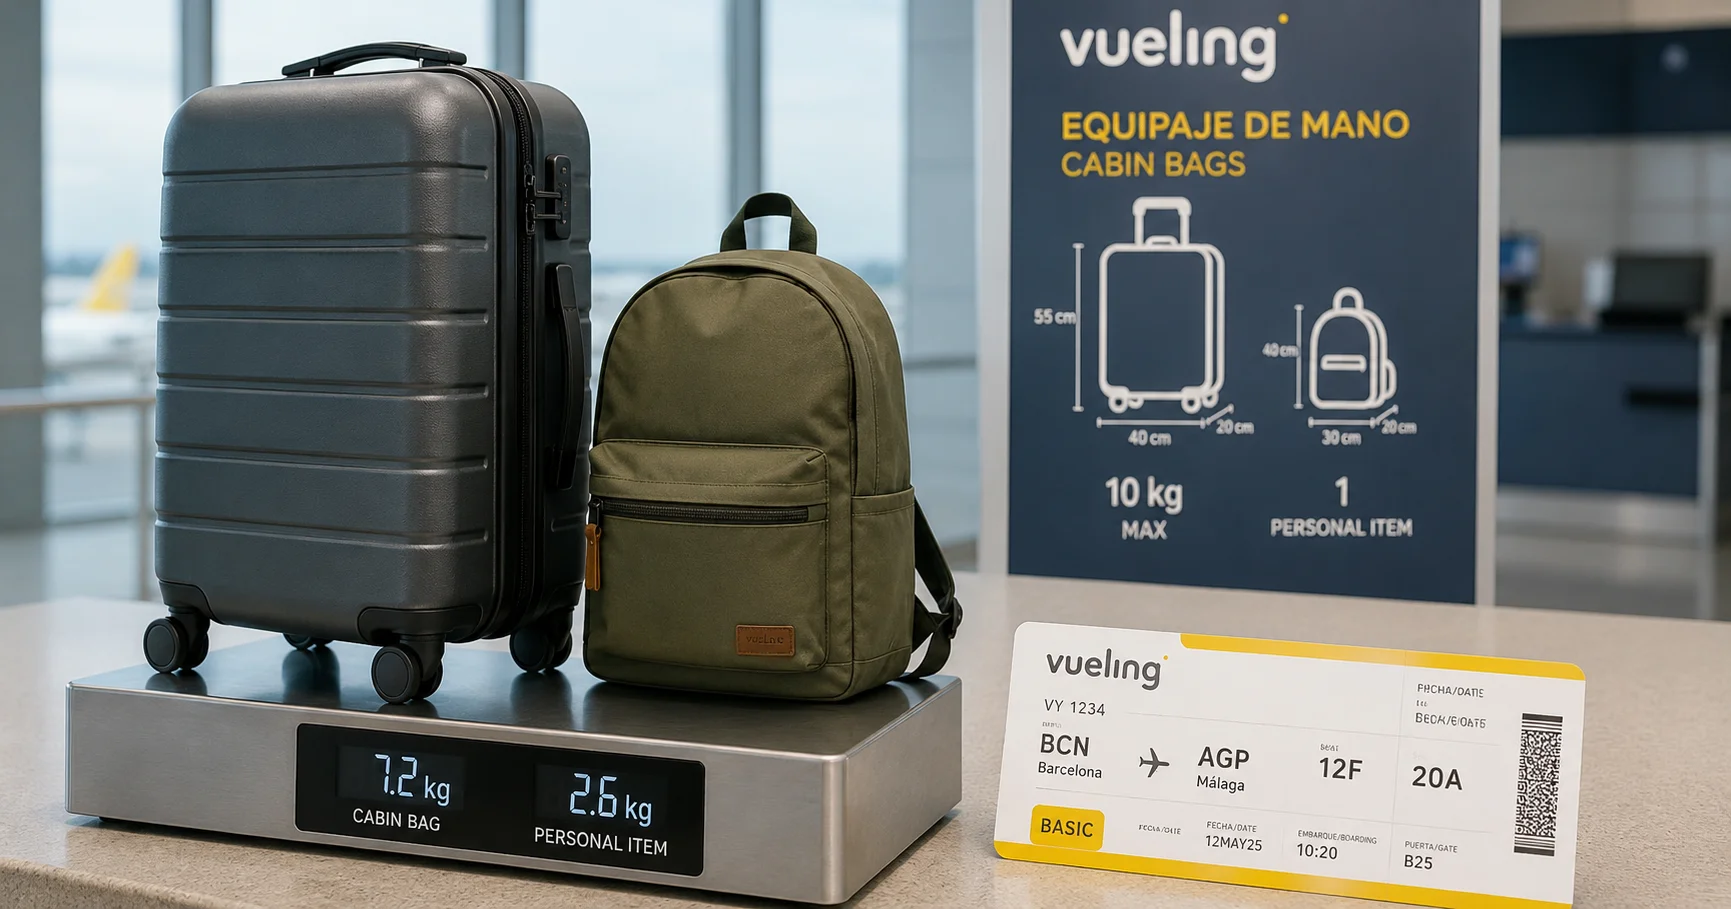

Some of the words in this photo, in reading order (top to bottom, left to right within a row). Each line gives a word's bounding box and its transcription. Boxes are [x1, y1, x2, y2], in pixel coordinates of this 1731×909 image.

[1060, 9, 1278, 83] vueling
[1062, 111, 1234, 143] EQUIPAJE
[1244, 111, 1291, 139] DE
[1301, 109, 1410, 139] MANO
[1061, 151, 1155, 177] CABIN
[1165, 151, 1246, 177] BAGS
[1034, 308, 1053, 325] 55
[1055, 311, 1076, 325] cm
[1262, 343, 1279, 358] 40
[1280, 346, 1299, 358] cm
[1216, 419, 1234, 435] 20
[1235, 422, 1254, 435] cm
[1381, 419, 1397, 435] 20
[1398, 422, 1417, 435] cm
[1128, 429, 1149, 446] 40
[1150, 433, 1171, 446] cm
[1322, 429, 1340, 446] 30
[1341, 433, 1362, 446] cm
[1105, 476, 1140, 508] 10
[1147, 475, 1183, 515] kg
[1335, 476, 1349, 508] 1
[1121, 520, 1168, 540] MAX
[1270, 518, 1366, 537] PERSONAL
[1370, 518, 1413, 537] ITEM
[1046, 648, 1161, 691] vueling
[1044, 698, 1064, 712] VY
[1070, 701, 1106, 716] 1234
[1040, 733, 1090, 757] BCN
[1197, 746, 1250, 770] AGP
[1038, 761, 1102, 779] Barcelona
[1319, 757, 1363, 780] 12F
[1412, 765, 1463, 791] 20A
[374, 753, 418, 798] 7.2
[424, 775, 451, 807] kg
[1196, 774, 1245, 794] Málaga
[569, 772, 618, 818] 2.6
[625, 794, 653, 827] kg
[352, 807, 402, 828] CABIN
[407, 814, 442, 832] BAG
[1040, 817, 1094, 838] BASIC
[1206, 820, 1258, 833] FECHA/DATE
[534, 826, 624, 852] PERSONAL
[628, 836, 668, 857] ITEM
[1205, 835, 1263, 852] 12MAY25
[1297, 829, 1378, 845] EMBARQUE/BOARDING
[1404, 840, 1458, 853] PUERTA/GATE
[1297, 843, 1338, 860] 10:20
[1404, 854, 1433, 870] B25
